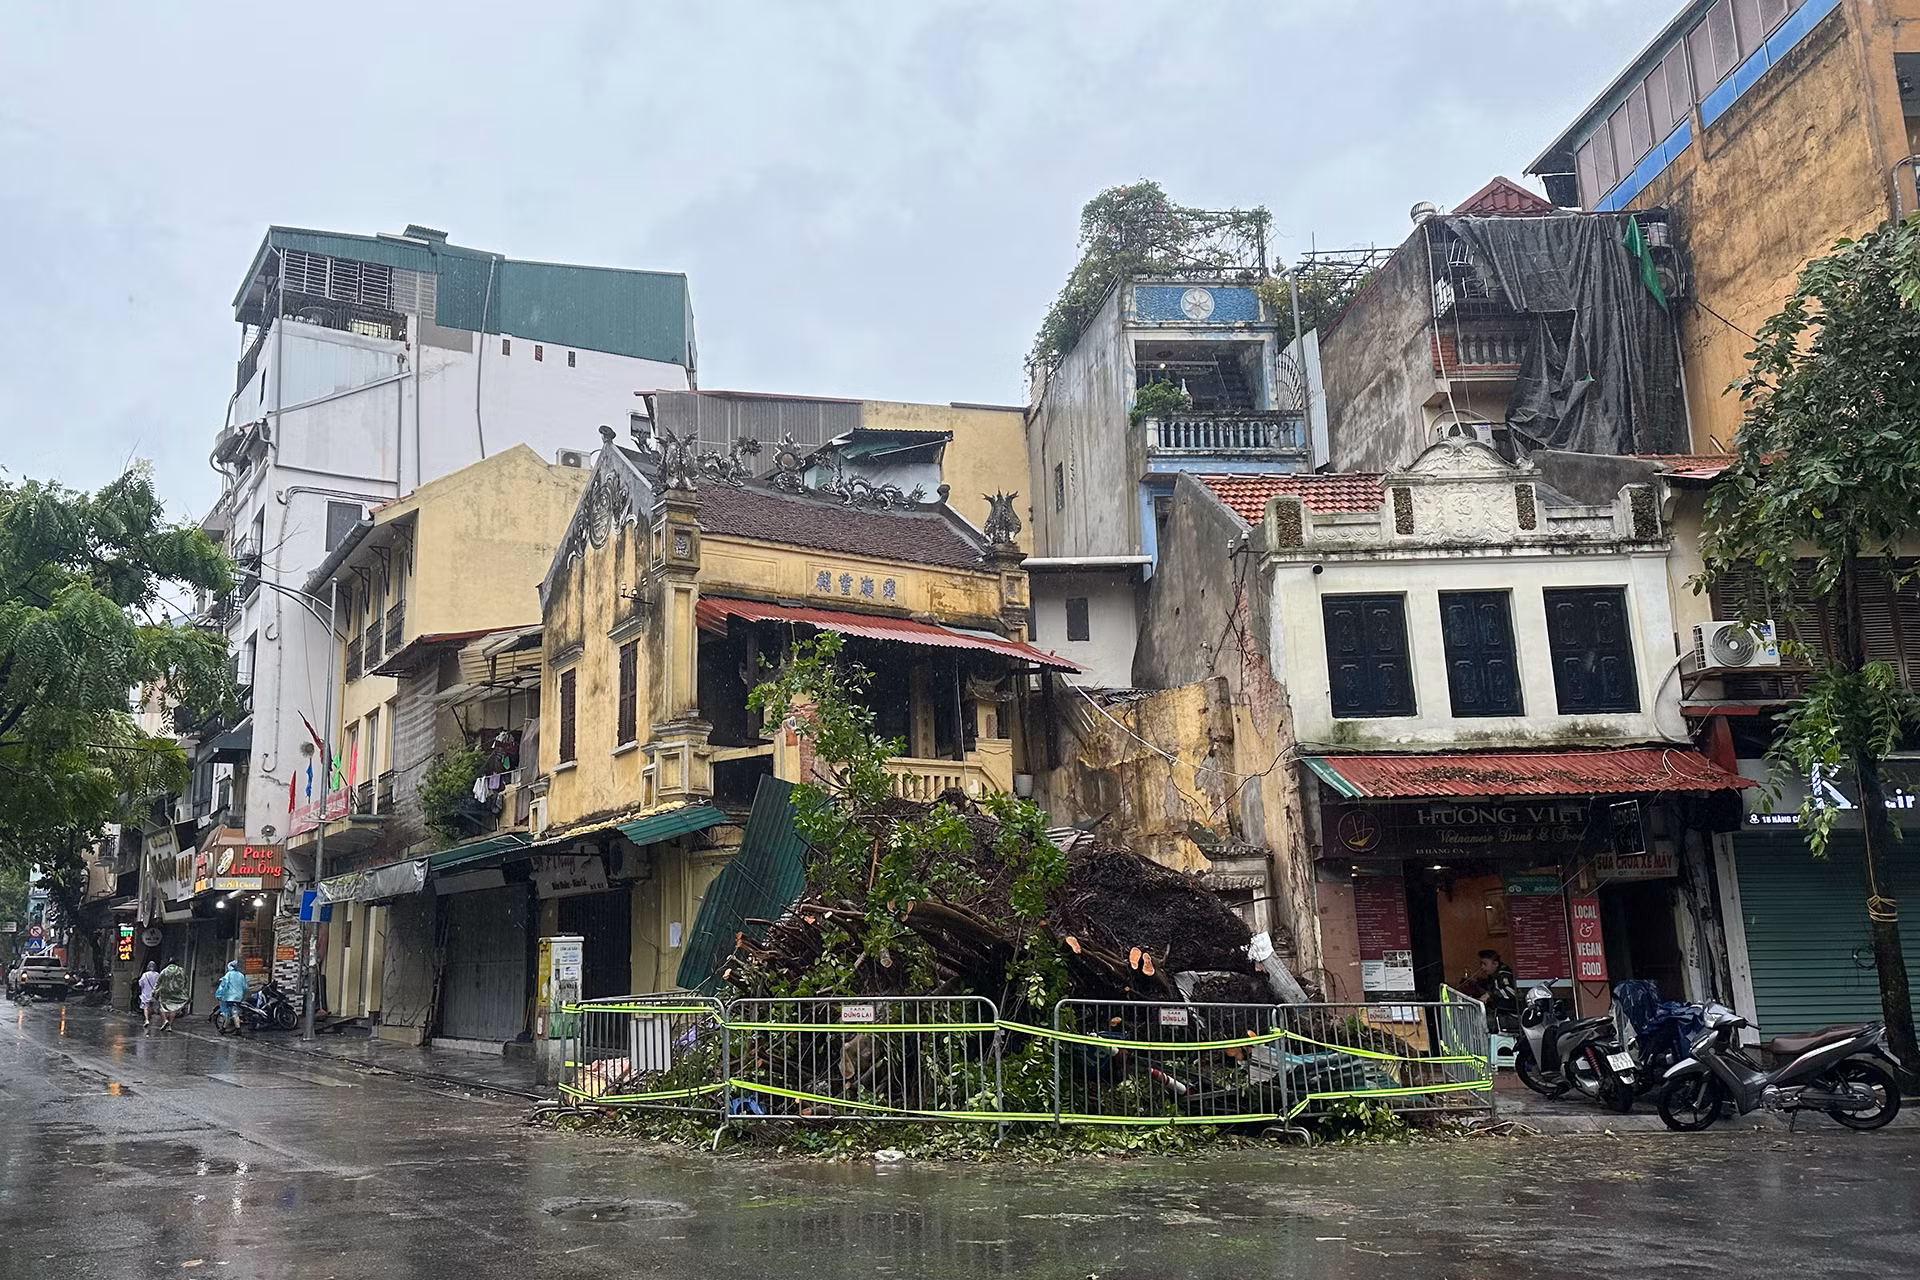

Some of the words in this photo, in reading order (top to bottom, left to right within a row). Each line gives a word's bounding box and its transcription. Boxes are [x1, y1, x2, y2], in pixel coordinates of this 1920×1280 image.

[1418, 806, 1517, 825] HƯƠNG
[1436, 829, 1495, 843] Vietnamese
[1499, 826, 1534, 843] Drink
[1536, 826, 1549, 841] &
[243, 846, 273, 859] Pate
[1640, 855, 1652, 868] XE
[1653, 852, 1673, 868] MÁY
[257, 860, 282, 877] Ông
[1574, 905, 1597, 919] LOCAL
[1580, 922, 1594, 938] &
[1576, 942, 1602, 956] VEGAN
[1582, 962, 1602, 976] FOOD
